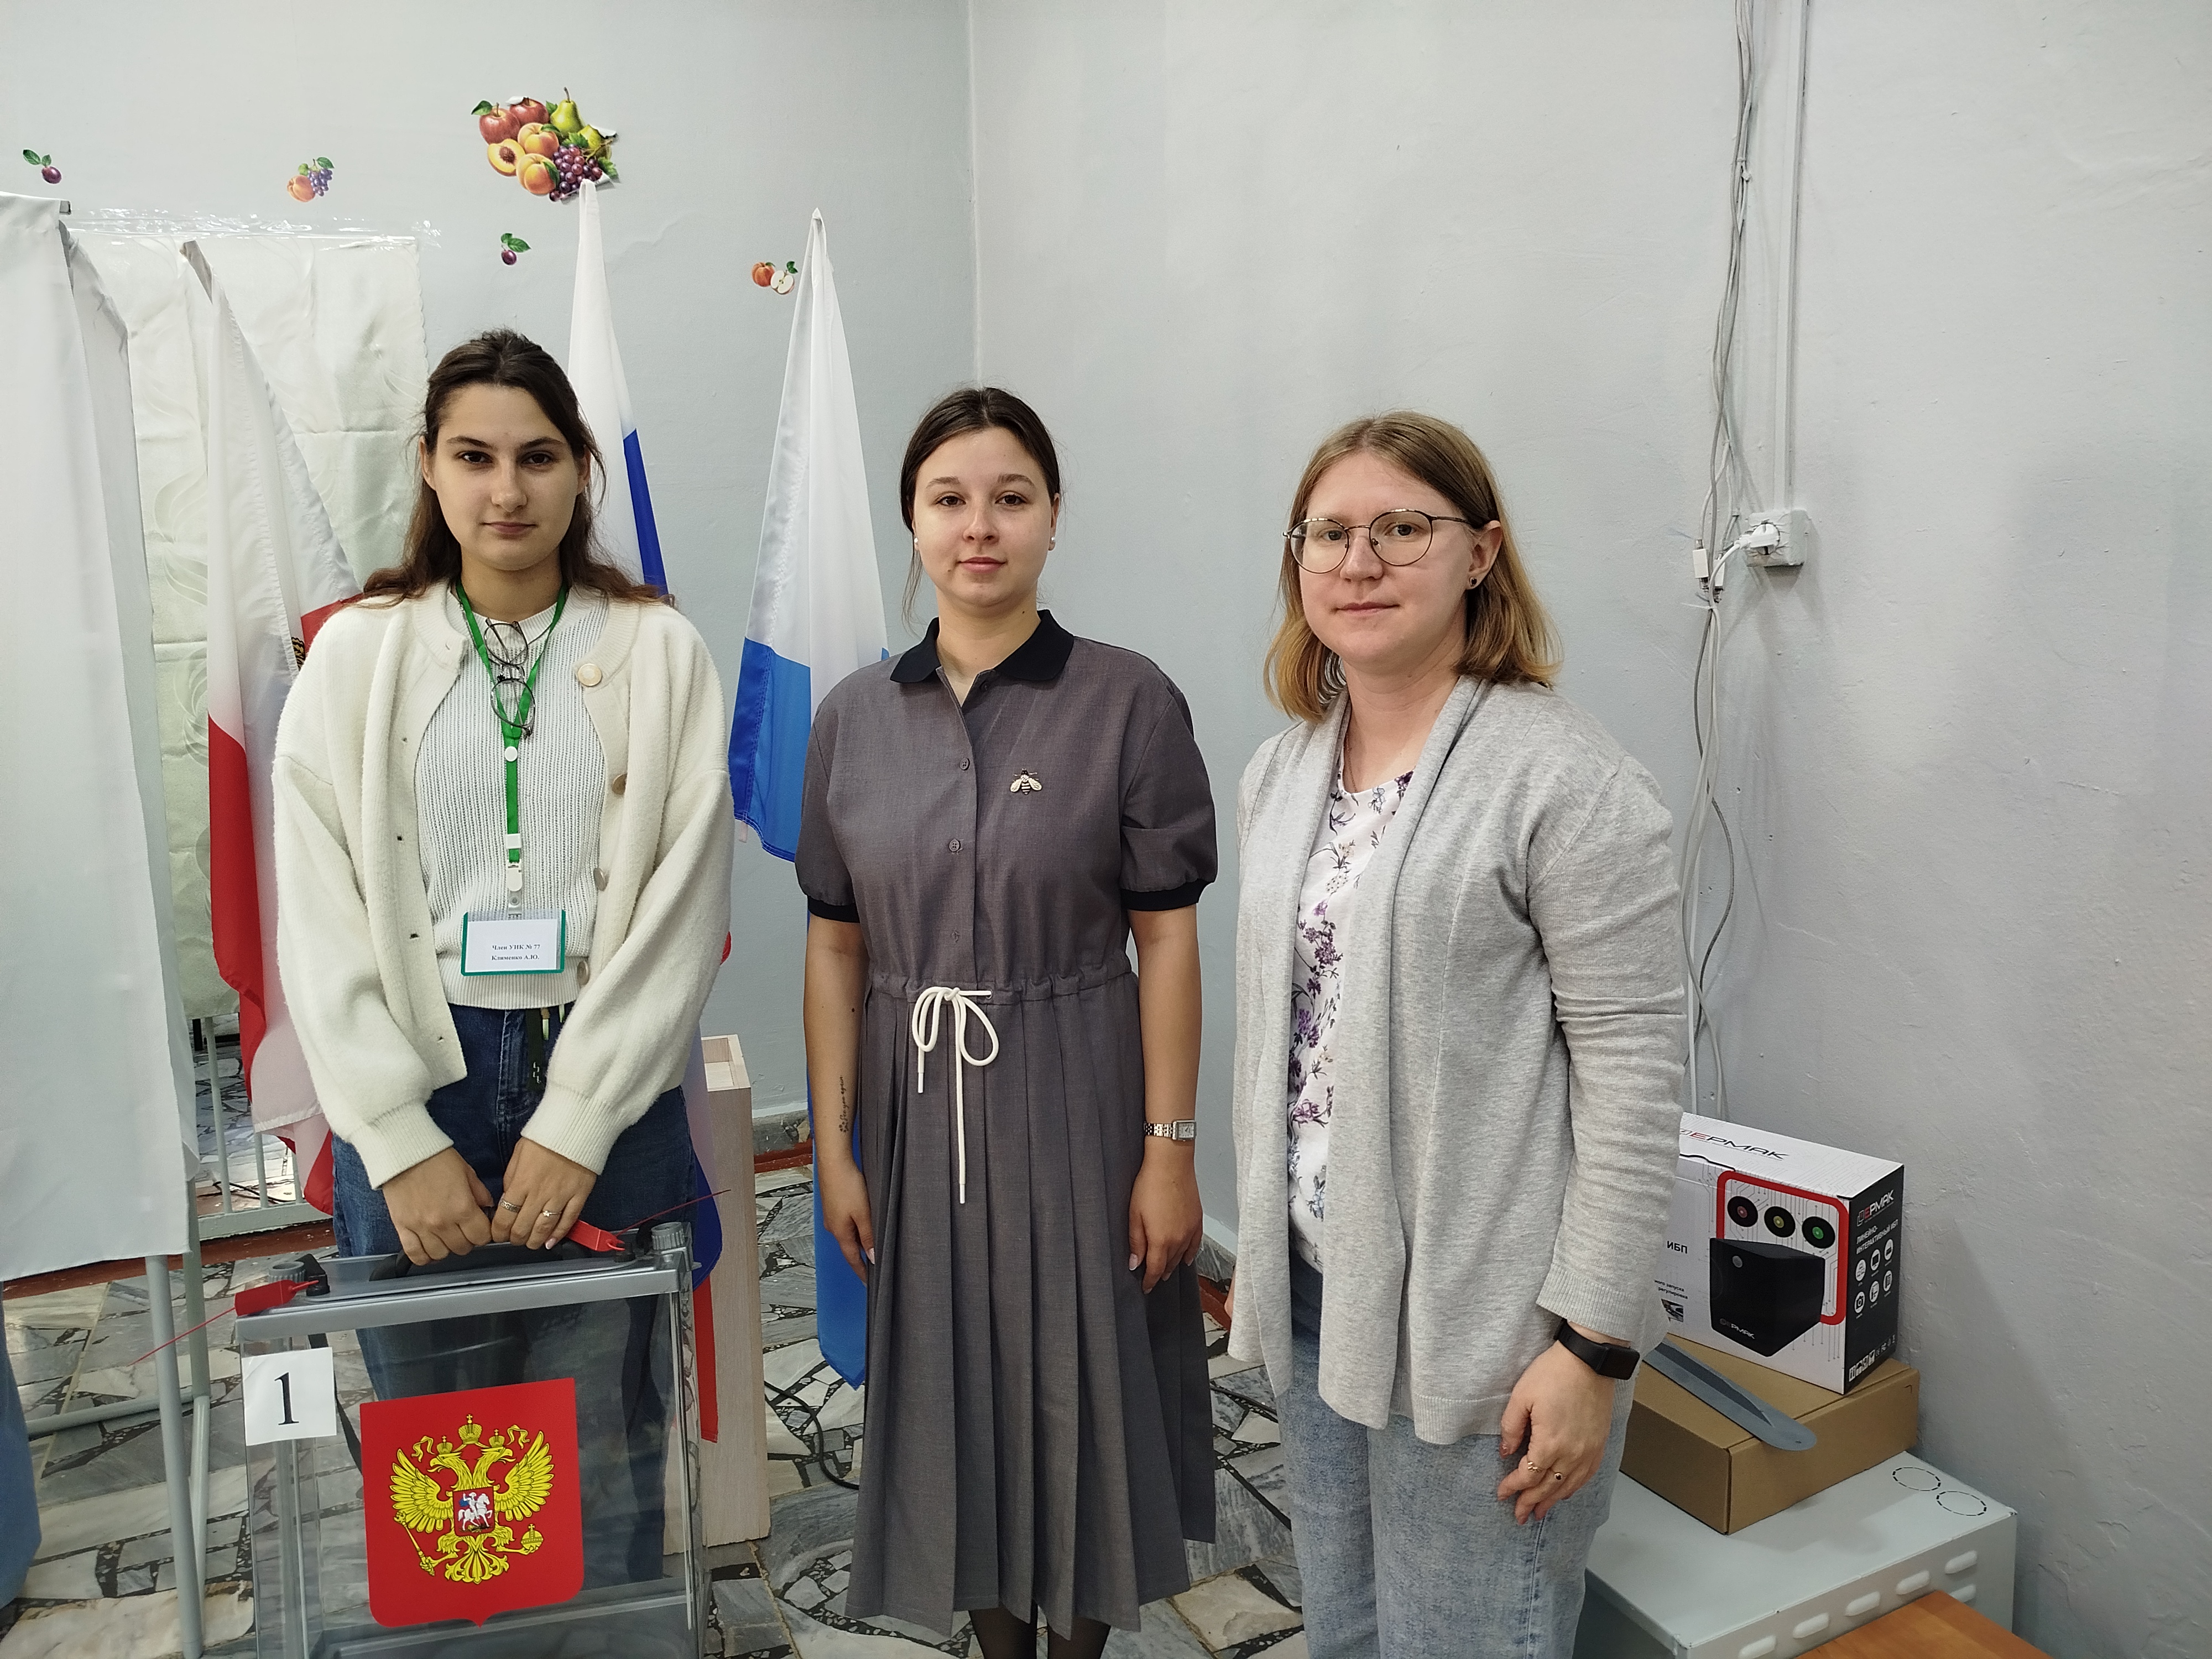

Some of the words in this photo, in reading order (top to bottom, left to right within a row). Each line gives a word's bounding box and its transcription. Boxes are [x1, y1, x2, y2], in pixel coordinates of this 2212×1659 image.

[1864, 1190, 1894, 1219] ЕРМАК
[1667, 1240, 1688, 1254] ИБП
[274, 1372, 300, 1426] 1
